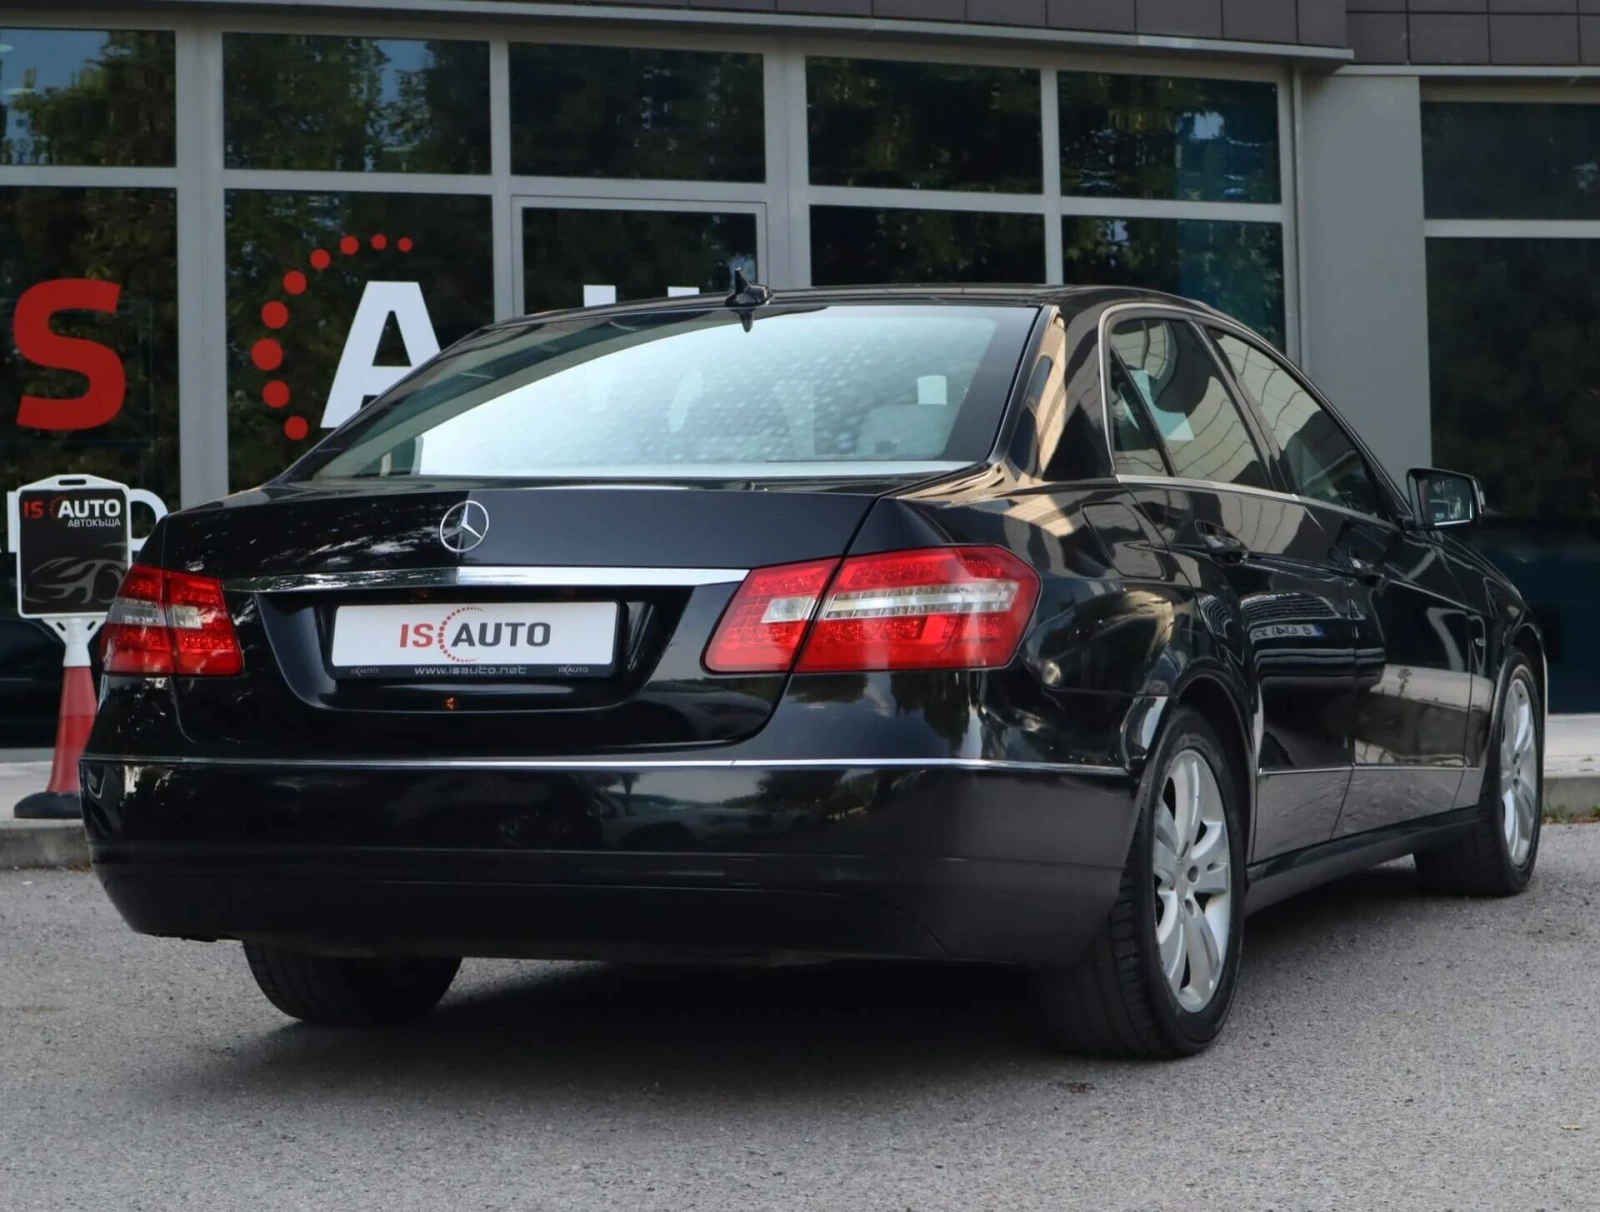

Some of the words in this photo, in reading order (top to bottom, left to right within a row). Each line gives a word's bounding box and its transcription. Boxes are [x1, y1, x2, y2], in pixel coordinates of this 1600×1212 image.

[23, 501, 45, 519] IS
[57, 498, 121, 519] AUTO
[67, 518, 121, 528] АВТОКЪЩА
[400, 623, 434, 648] IS
[450, 622, 552, 648] AUTO
[414, 665, 527, 675] www.isauto.net
